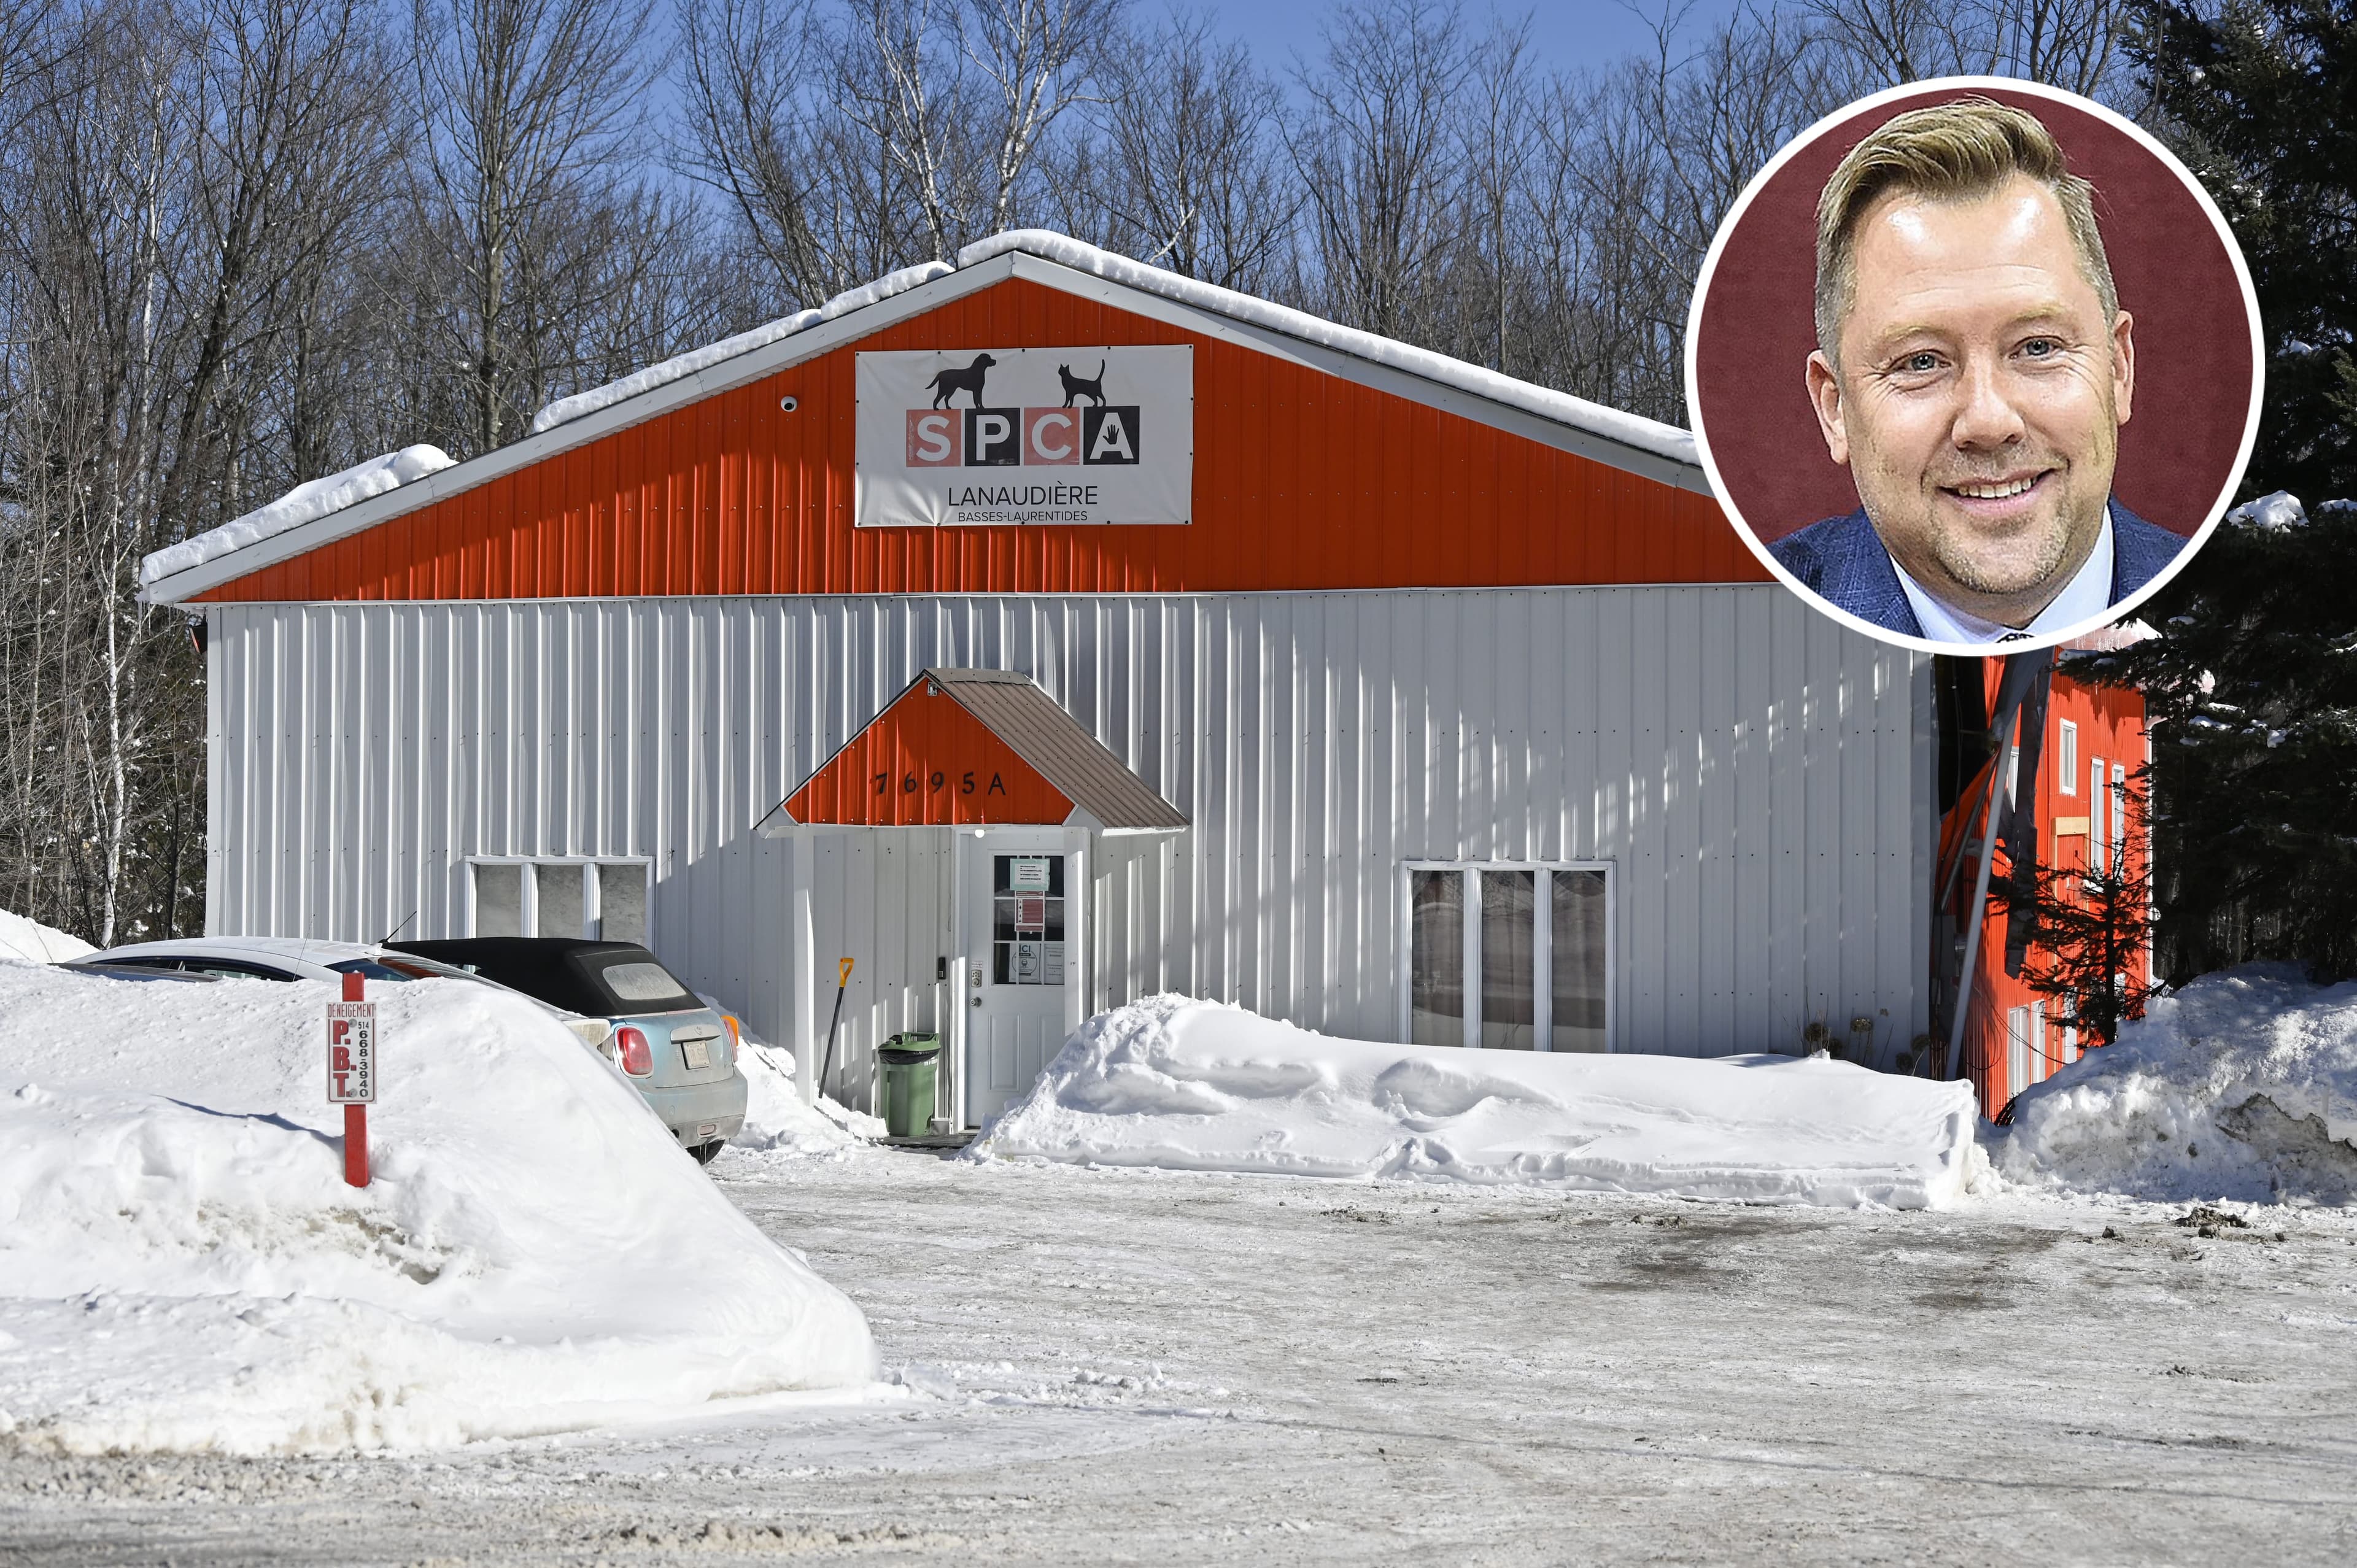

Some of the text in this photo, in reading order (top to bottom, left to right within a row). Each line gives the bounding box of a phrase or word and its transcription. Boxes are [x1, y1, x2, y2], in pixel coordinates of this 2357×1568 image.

[916, 412, 1134, 462] SPCA
[948, 481, 1098, 506] LANAUDIÈRE
[958, 511, 1088, 522] BASSES-LAURENTIDES
[875, 771, 1006, 796] 7695A
[358, 1021, 369, 1030] 514
[359, 1030, 368, 1097] 668-3940
